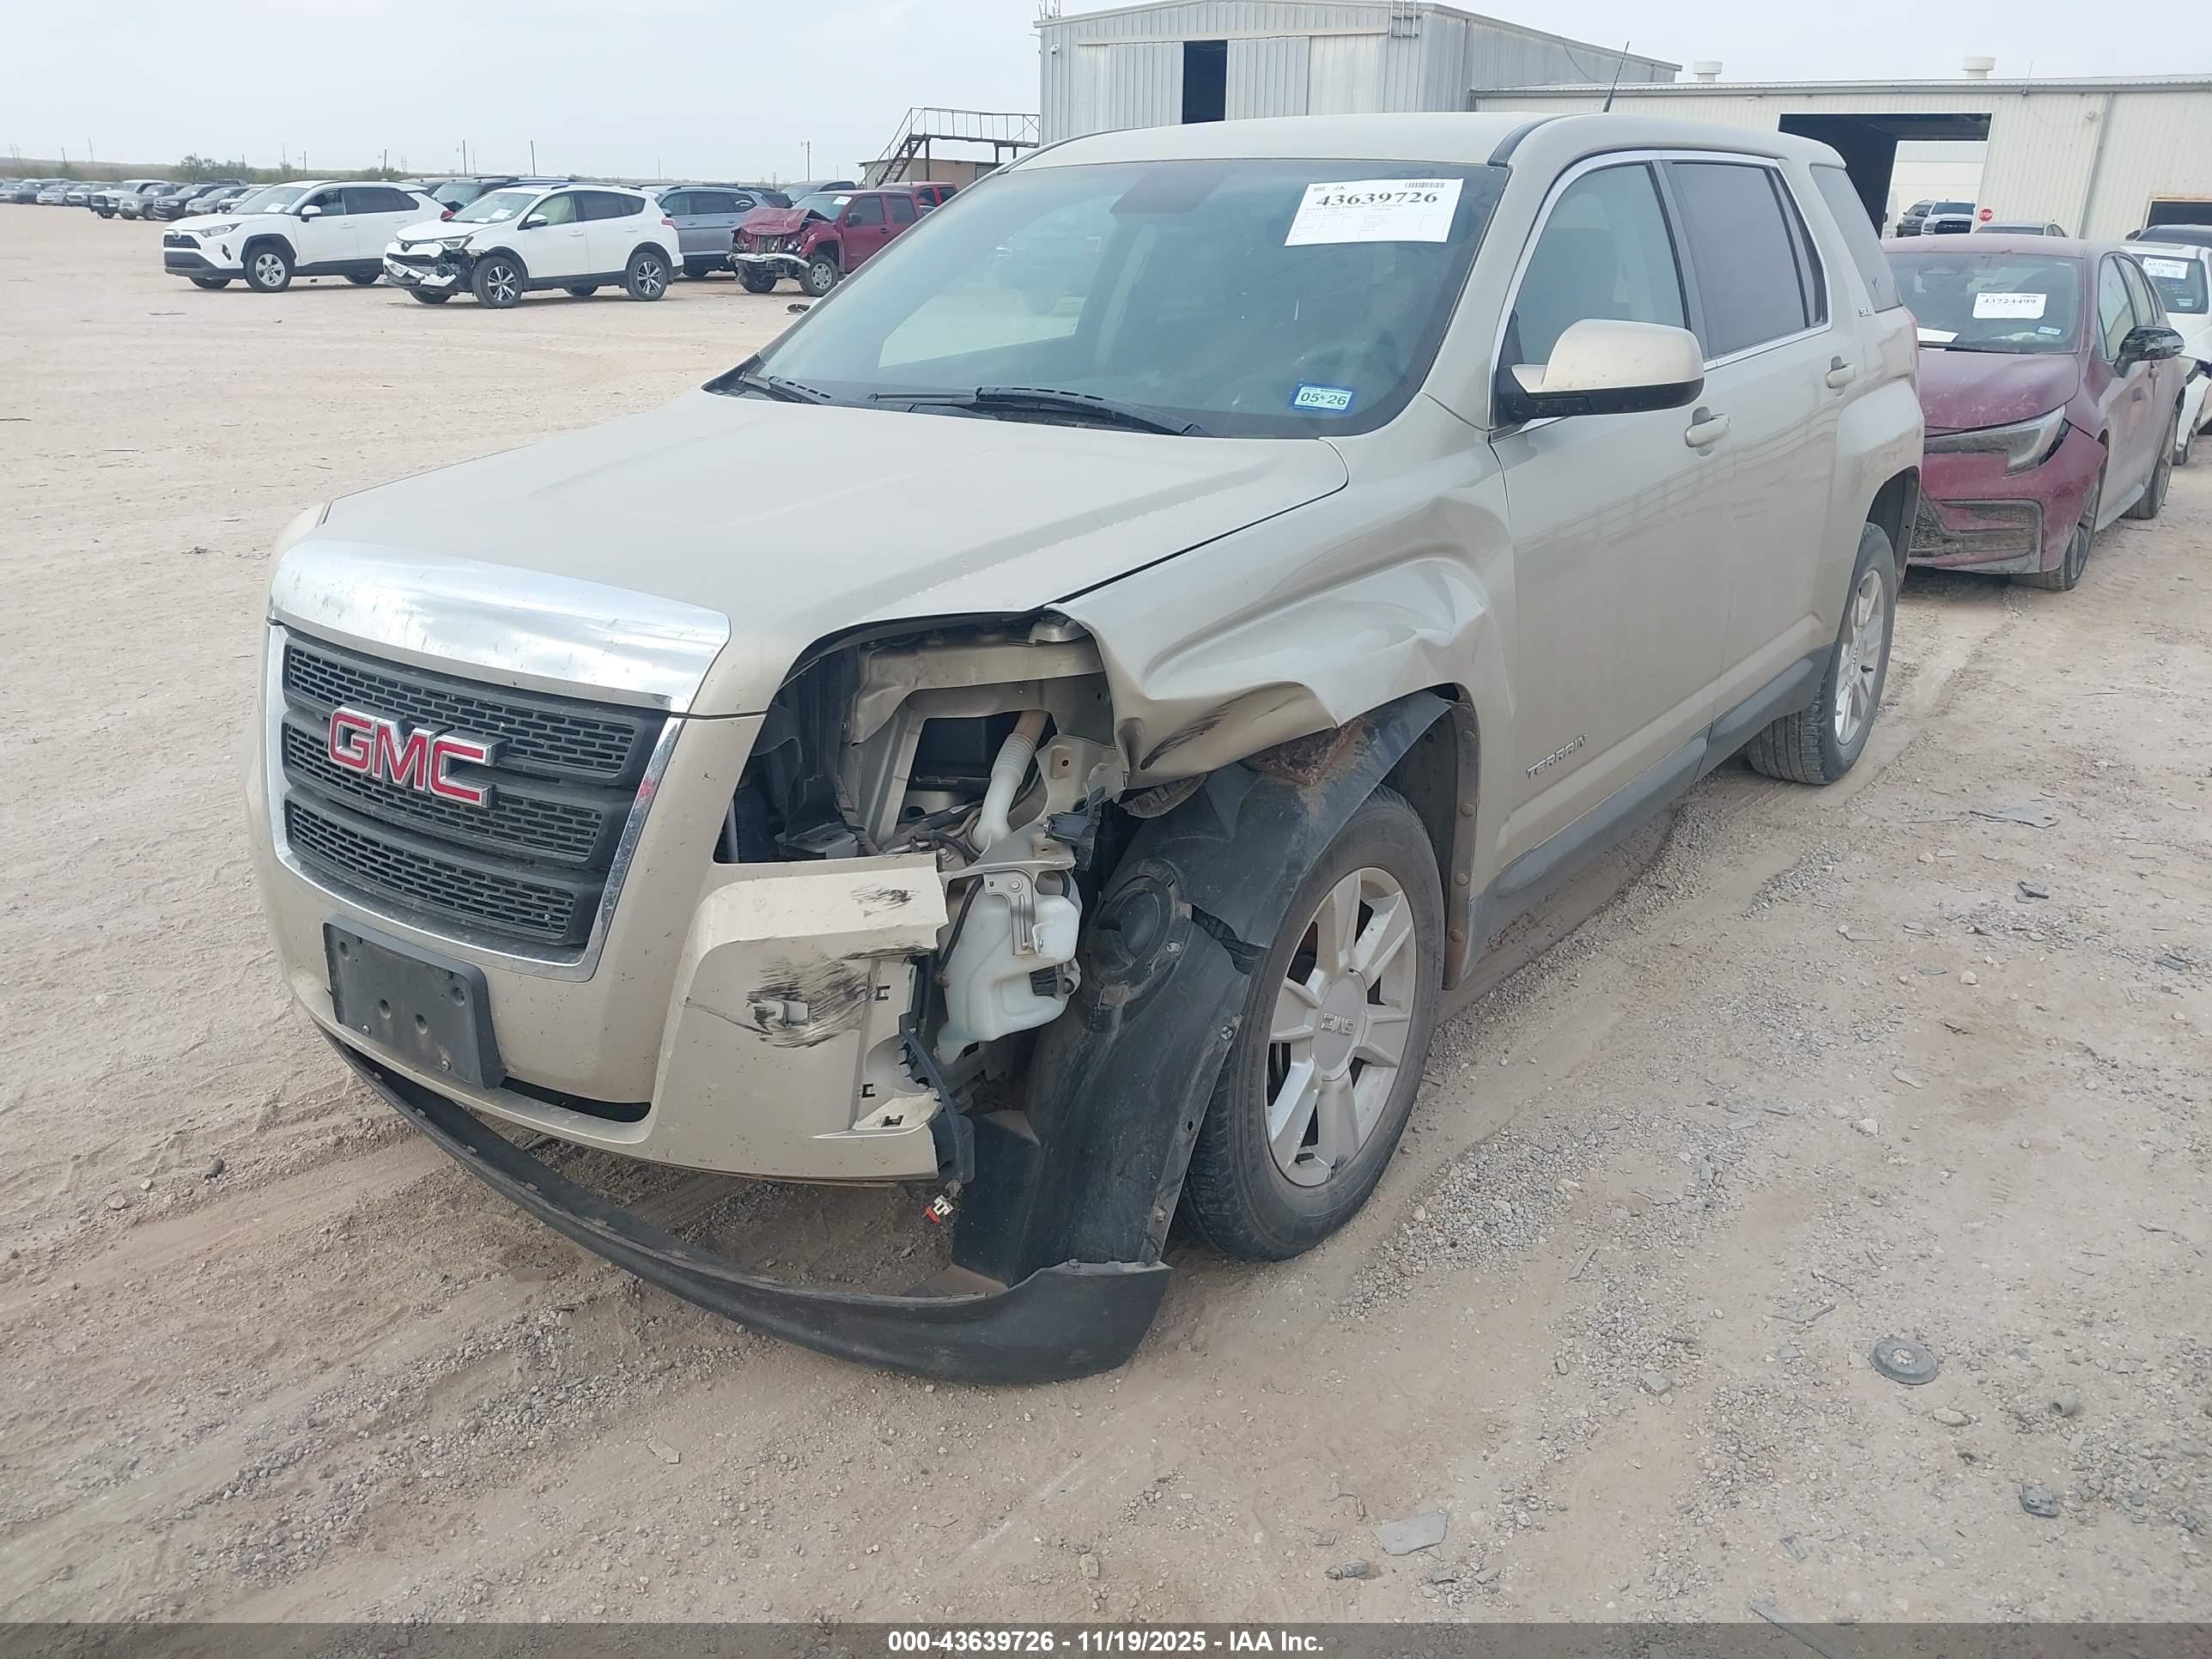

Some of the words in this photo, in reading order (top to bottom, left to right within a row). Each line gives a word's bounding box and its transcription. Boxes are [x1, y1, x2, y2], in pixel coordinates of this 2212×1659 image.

[1316, 192, 1438, 206] 43639726
[329, 707, 489, 808] GMC
[1525, 735, 1587, 780] TERRAIN
[1321, 1012, 1354, 1036] GMC
